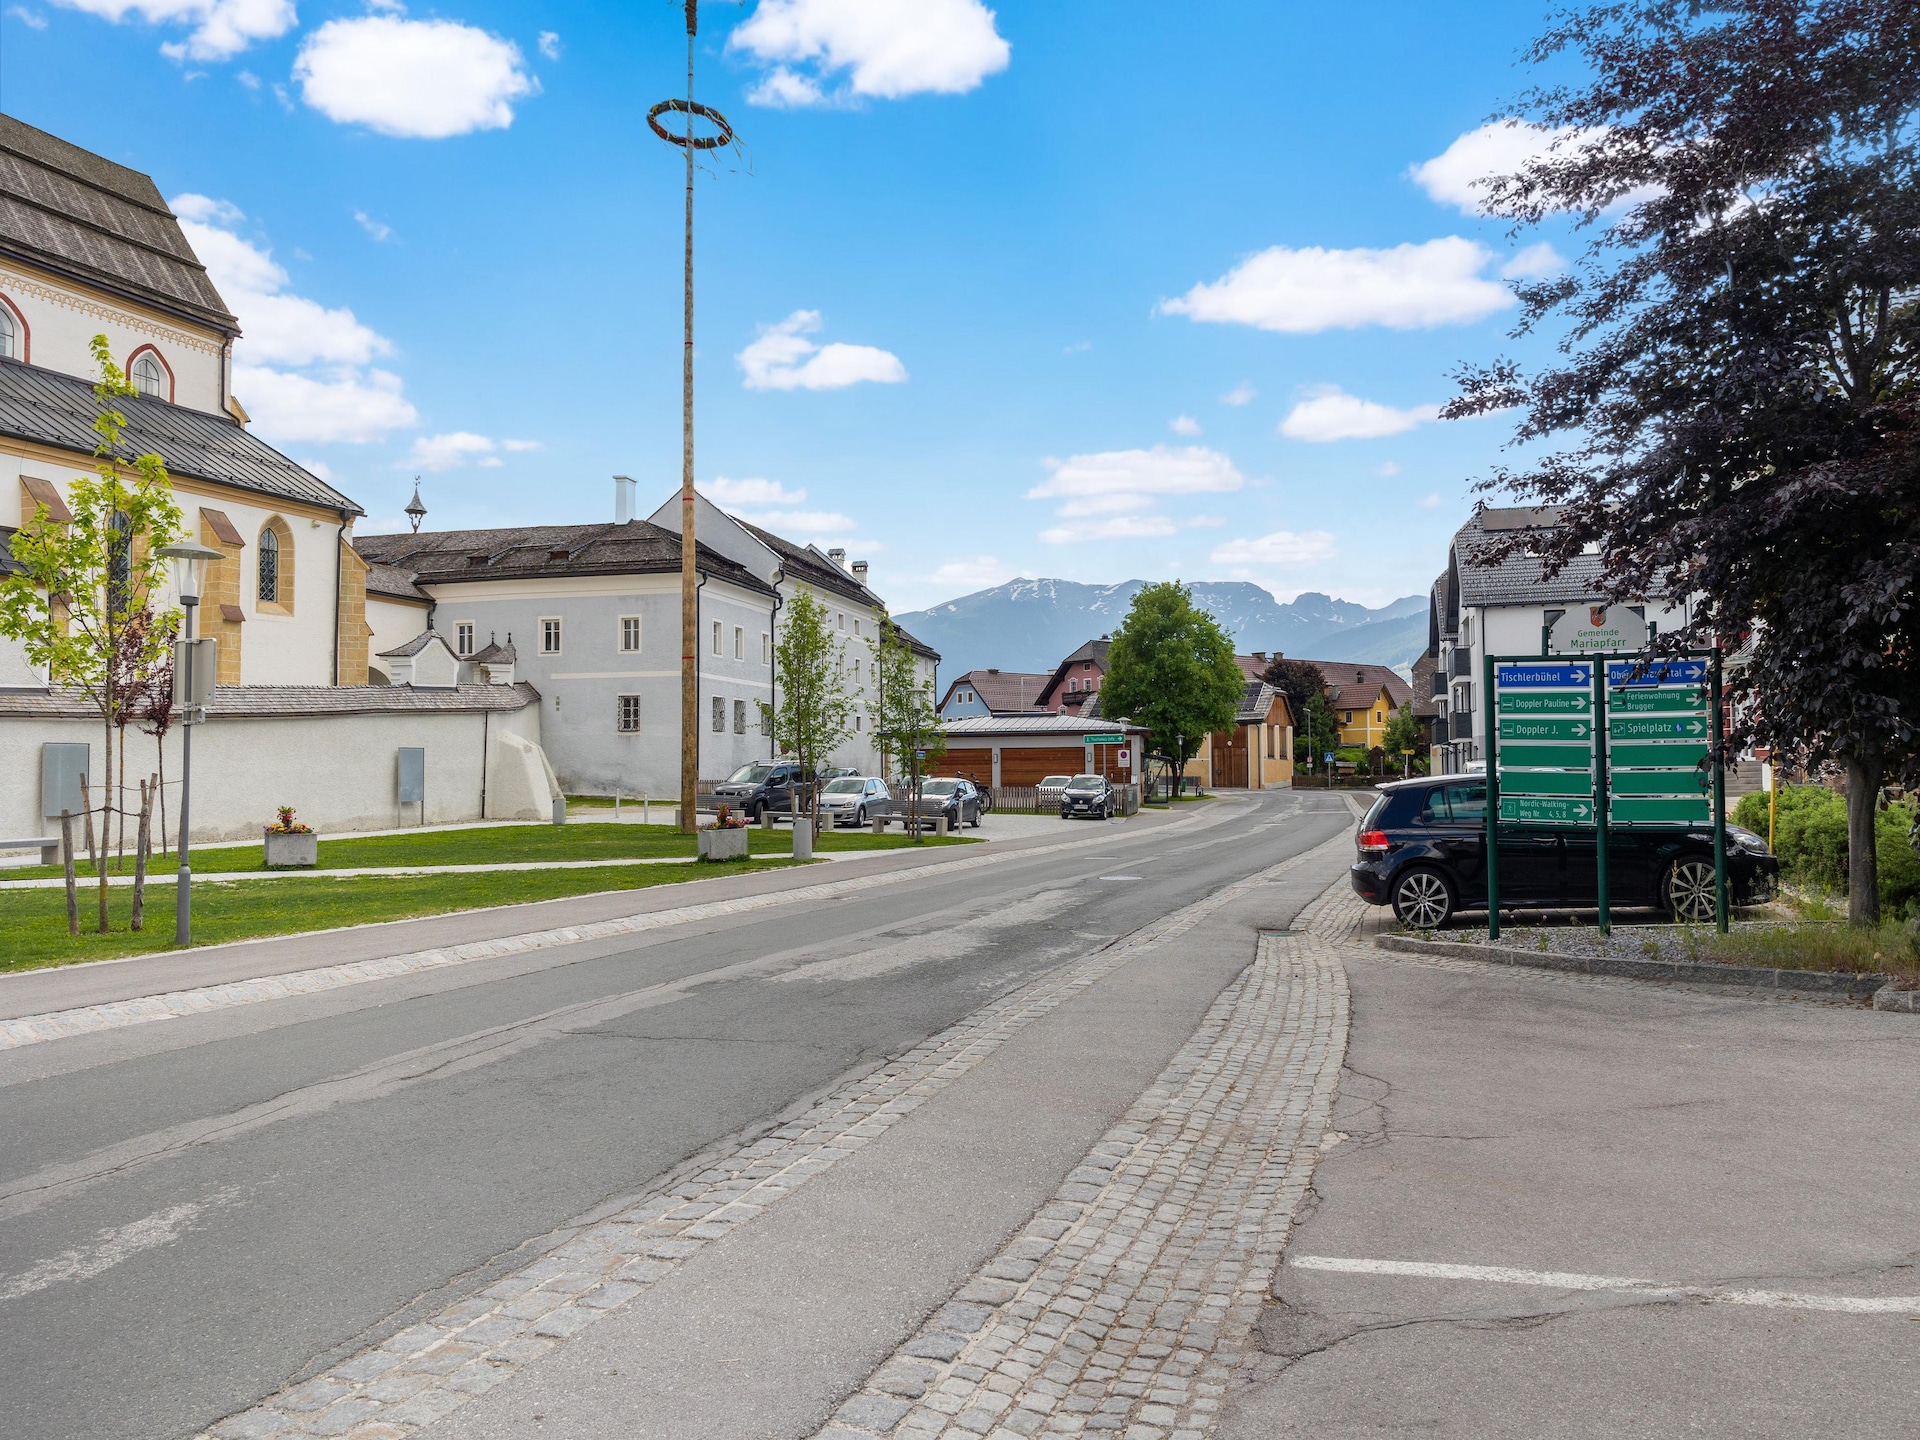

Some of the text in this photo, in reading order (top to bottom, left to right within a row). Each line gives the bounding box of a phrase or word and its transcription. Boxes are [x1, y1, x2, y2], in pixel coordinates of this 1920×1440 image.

[1577, 629, 1620, 637] Gemeinde
[1570, 638, 1627, 649] Mariapfarr
[1501, 672, 1560, 681] Tischlerbühel
[1626, 692, 1680, 700] Ferienwohnung
[1516, 699, 1569, 709] Doppler Pauline
[1627, 703, 1655, 711] Brugger
[1516, 724, 1559, 736] Doppler J.
[1627, 723, 1672, 734] Spielplatz
[1520, 810, 1531, 818] Weg
